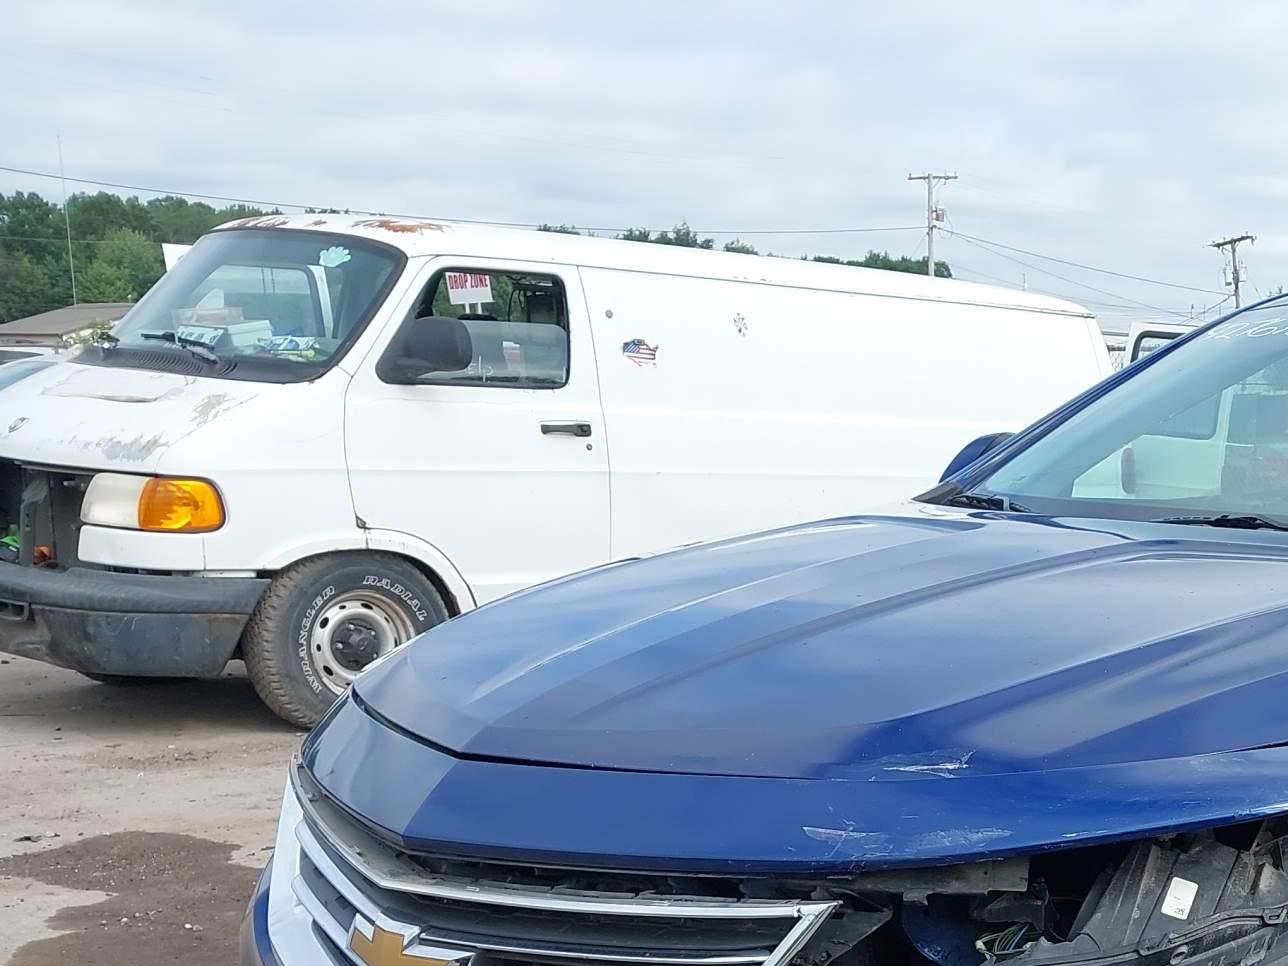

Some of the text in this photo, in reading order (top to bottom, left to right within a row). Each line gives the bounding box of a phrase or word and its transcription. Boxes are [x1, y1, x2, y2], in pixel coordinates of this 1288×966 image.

[448, 274, 468, 289] DROP
[297, 575, 428, 694] WRANGLER RADIAL
